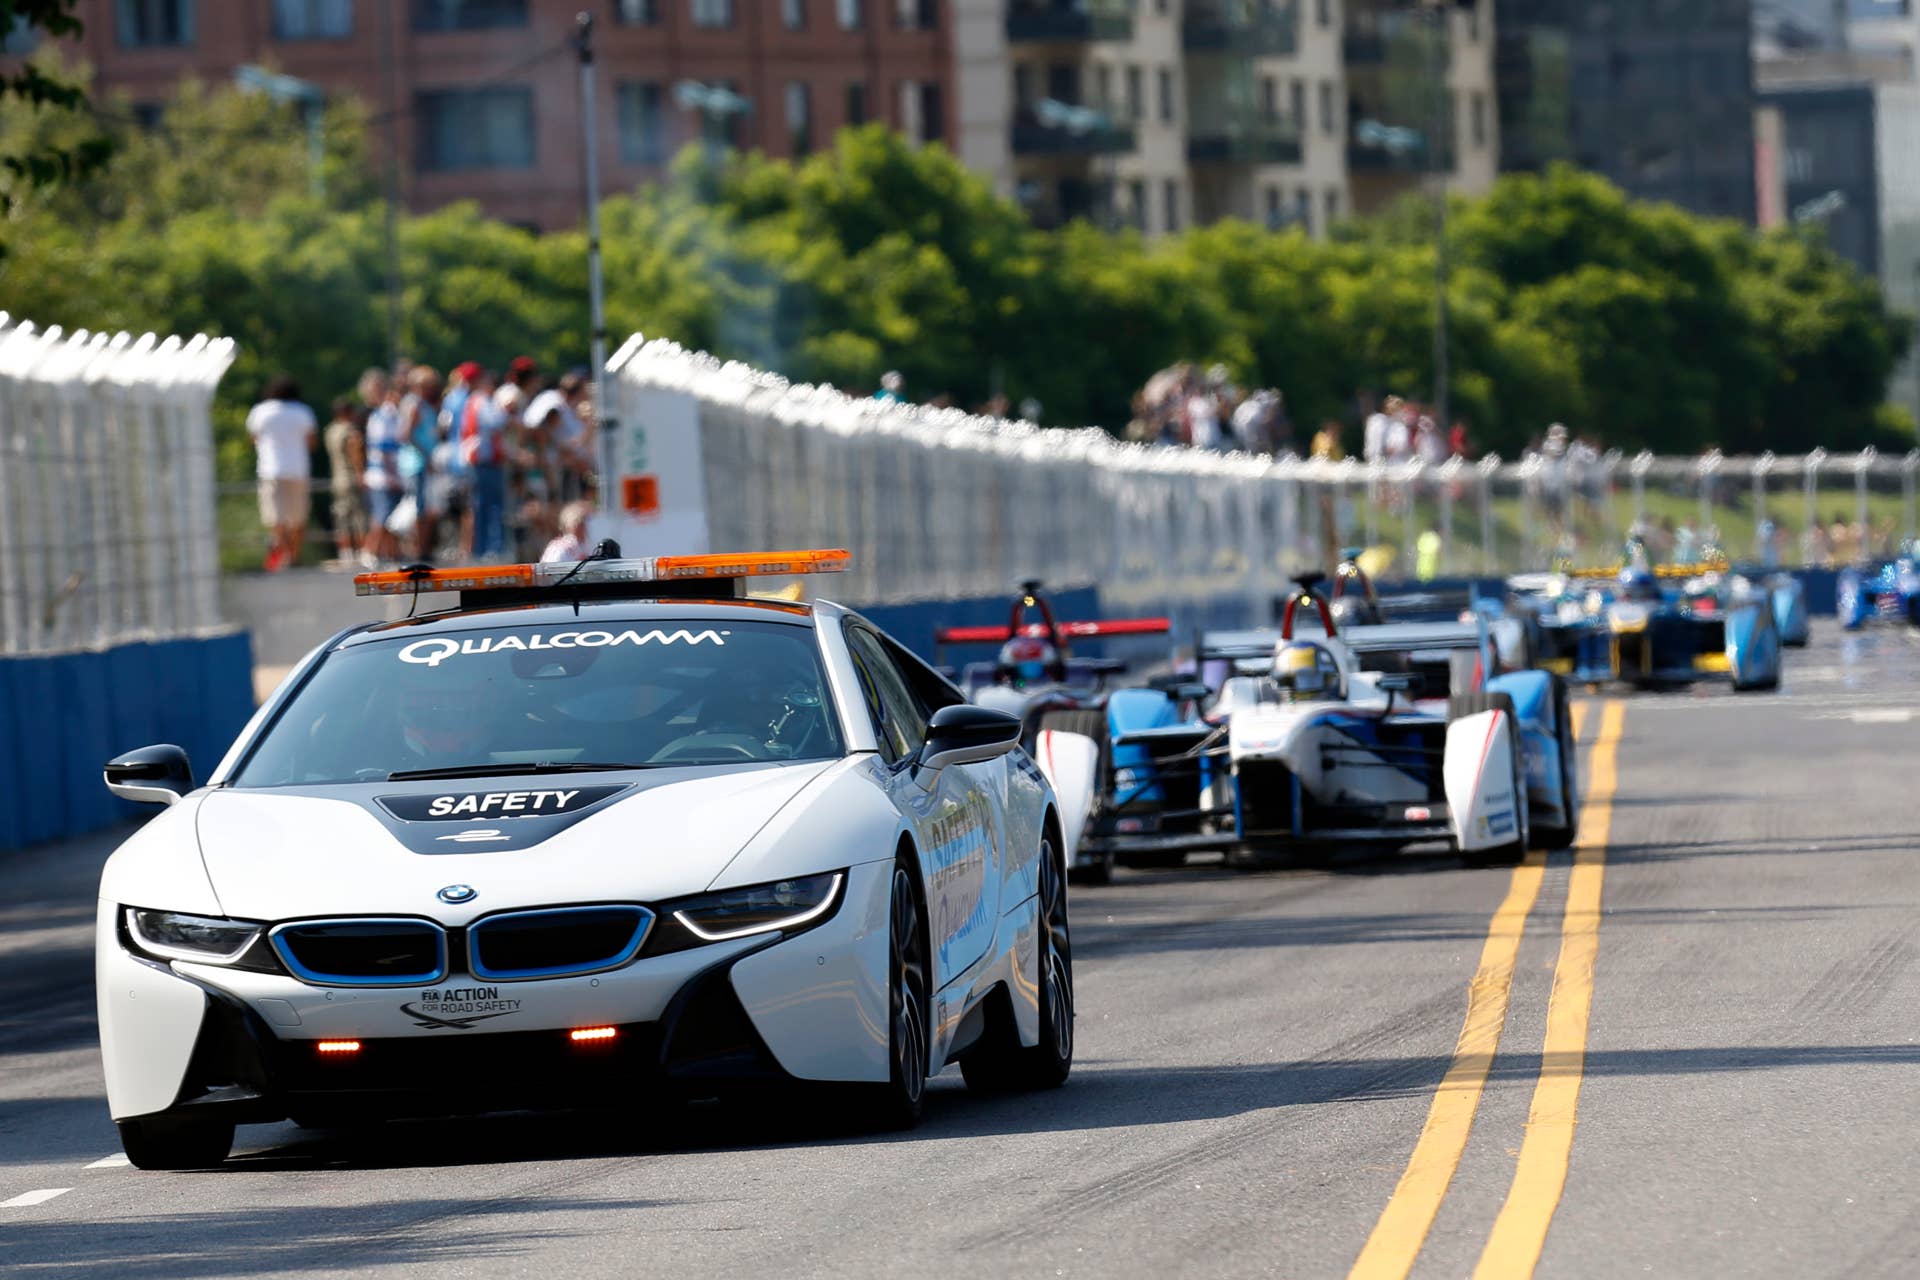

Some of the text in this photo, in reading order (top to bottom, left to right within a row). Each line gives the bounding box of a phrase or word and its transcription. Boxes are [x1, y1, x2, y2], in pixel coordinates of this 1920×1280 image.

[398, 629, 725, 666] QUALCOMM
[428, 790, 580, 816] SAFETY
[422, 986, 498, 1002] FIA ACTION
[422, 1000, 520, 1013] FOR ROAD SAFETY
